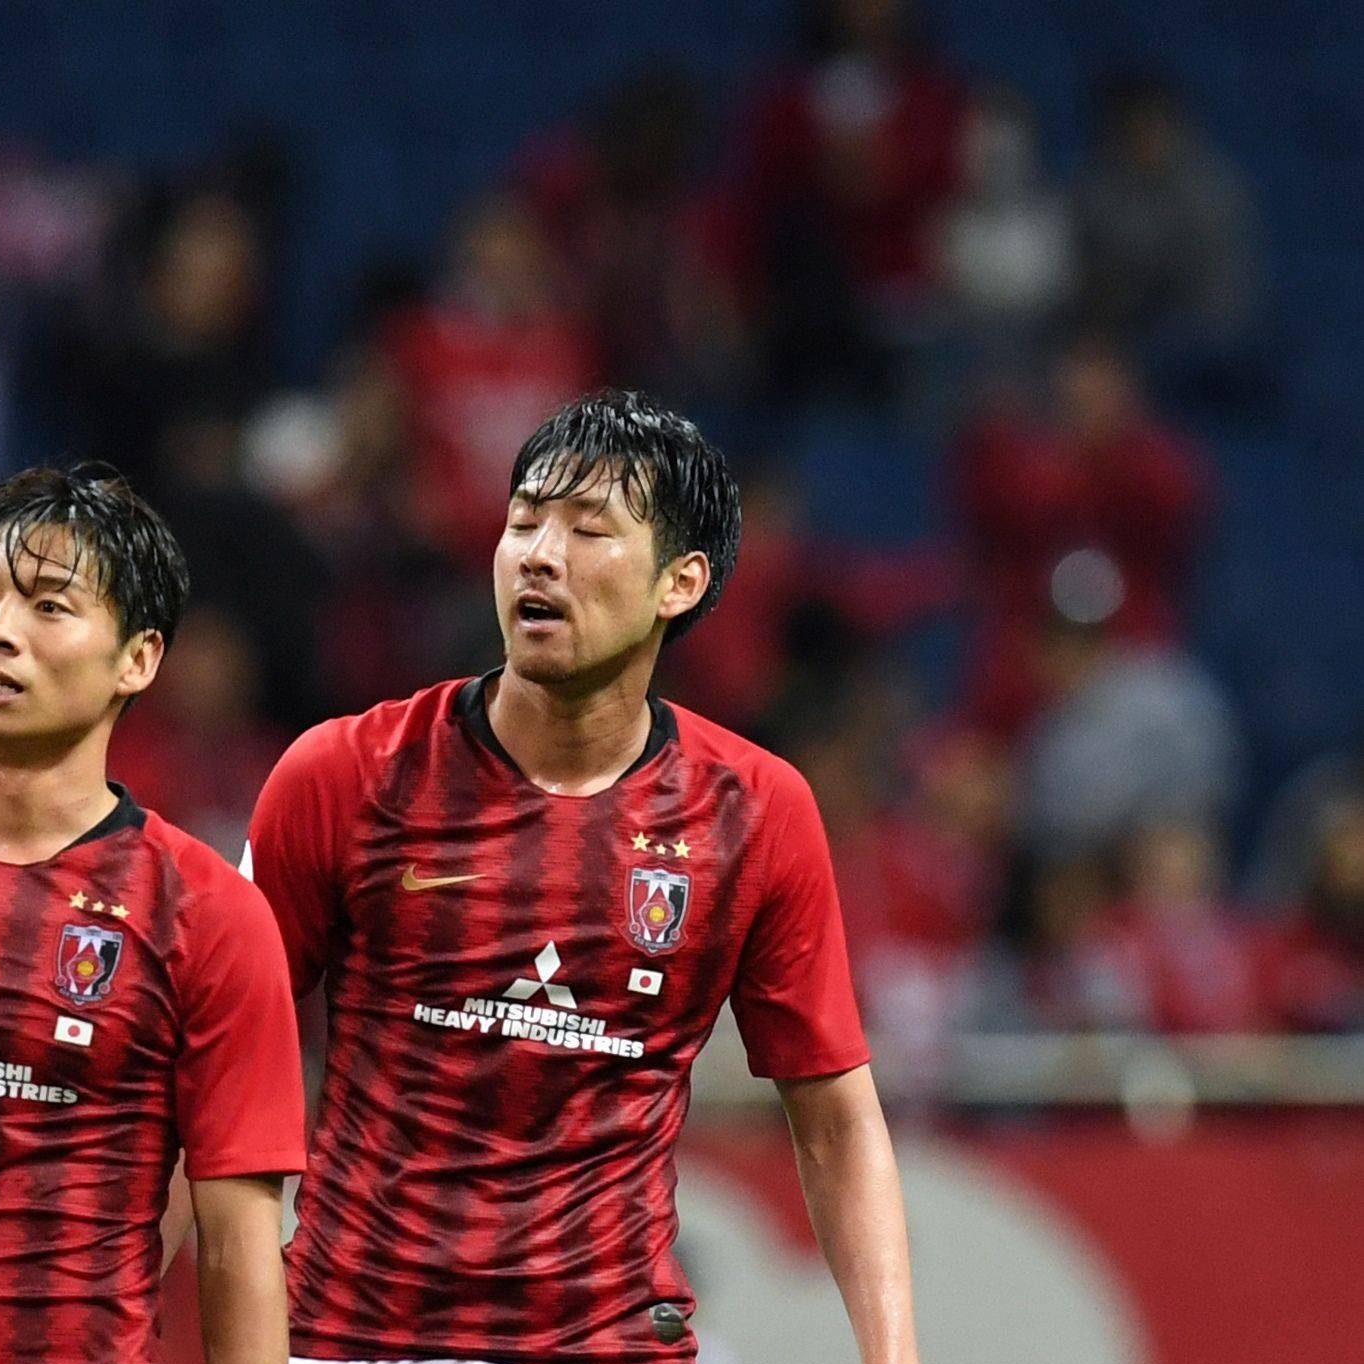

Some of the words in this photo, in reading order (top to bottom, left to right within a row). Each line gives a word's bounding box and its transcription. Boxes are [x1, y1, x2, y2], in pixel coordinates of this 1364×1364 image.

[413, 1003, 496, 1034] HEAVY
[501, 1019, 644, 1059] INDUSTRIES
[462, 997, 606, 1036] MITSUBISHI
